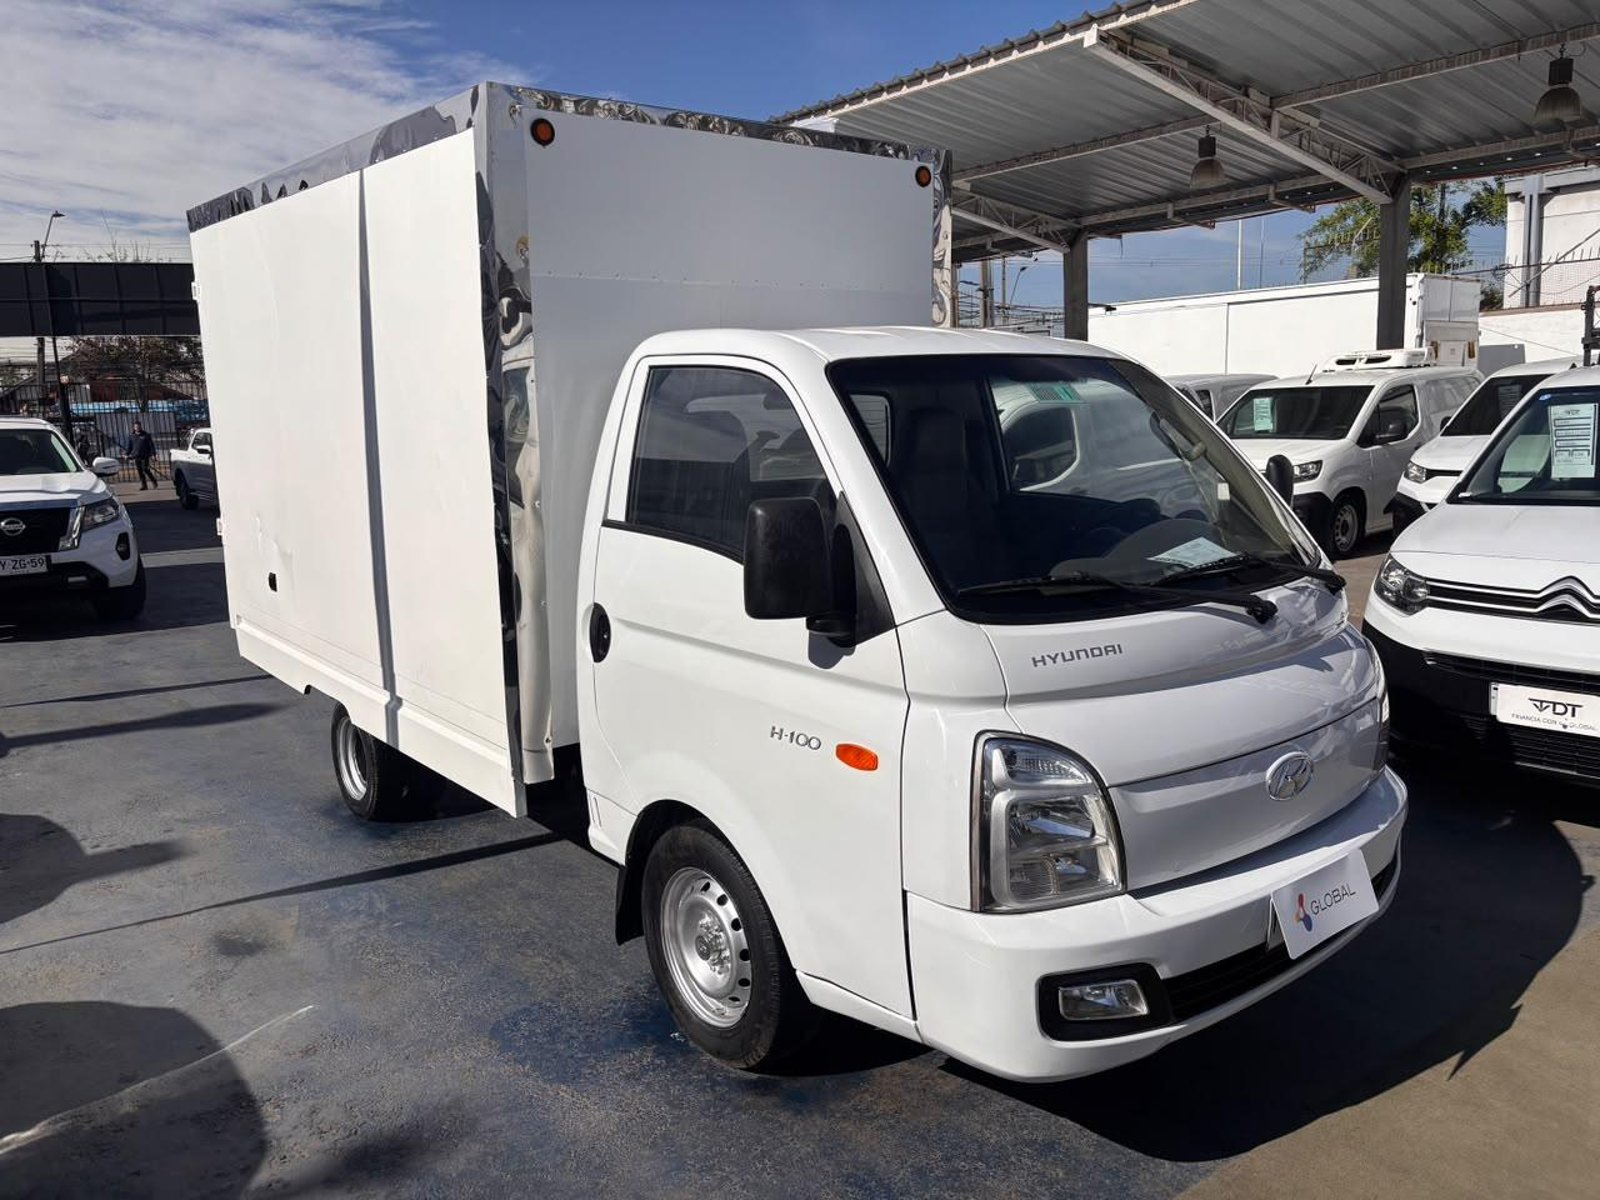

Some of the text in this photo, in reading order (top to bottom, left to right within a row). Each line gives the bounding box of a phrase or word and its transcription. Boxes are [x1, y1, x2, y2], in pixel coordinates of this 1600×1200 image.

[1031, 643, 1123, 668] HYUNDAI
[769, 725, 822, 751] H-100
[1310, 883, 1356, 916] GLOBAL
